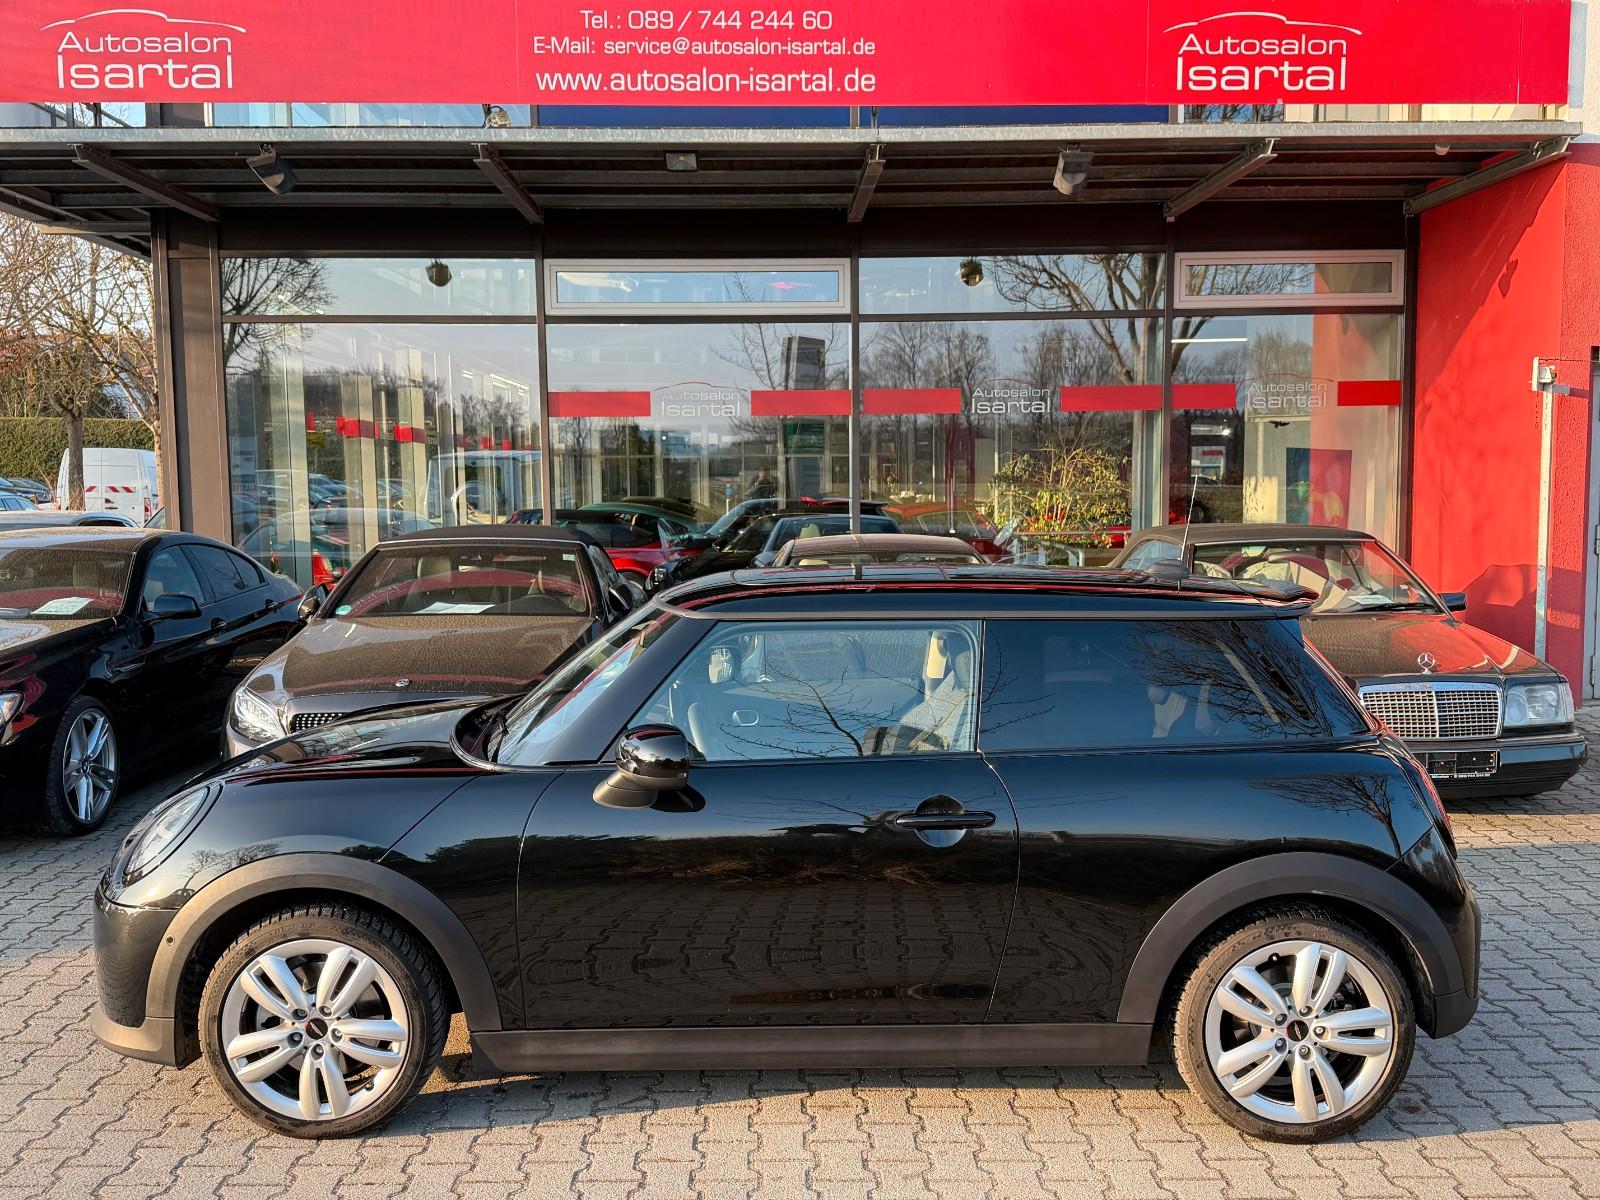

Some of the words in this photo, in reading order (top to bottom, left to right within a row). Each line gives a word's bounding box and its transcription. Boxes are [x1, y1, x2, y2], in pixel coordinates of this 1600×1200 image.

[580, 10, 621, 29] Tel.:
[628, 11, 673, 29] 089
[678, 11, 692, 32] /
[698, 11, 743, 29] 744
[750, 11, 795, 29] 244
[802, 11, 833, 29] 60
[58, 31, 231, 53] Autosalon
[533, 36, 595, 54] E-Mail:
[604, 37, 876, 55] service@autosalon-isartal.de
[1179, 34, 1346, 55] Autosalon
[57, 55, 233, 89] Isartal
[536, 67, 876, 92] www.autosalon-isartal.de
[1176, 57, 1346, 91] Isartal
[664, 390, 739, 400] Autosalon
[971, 387, 1050, 398] Autosalon
[1248, 382, 1327, 392] Autosalon
[661, 401, 740, 417] Isartal
[971, 397, 1050, 414] Isartal
[1247, 392, 1327, 408] Isartal
